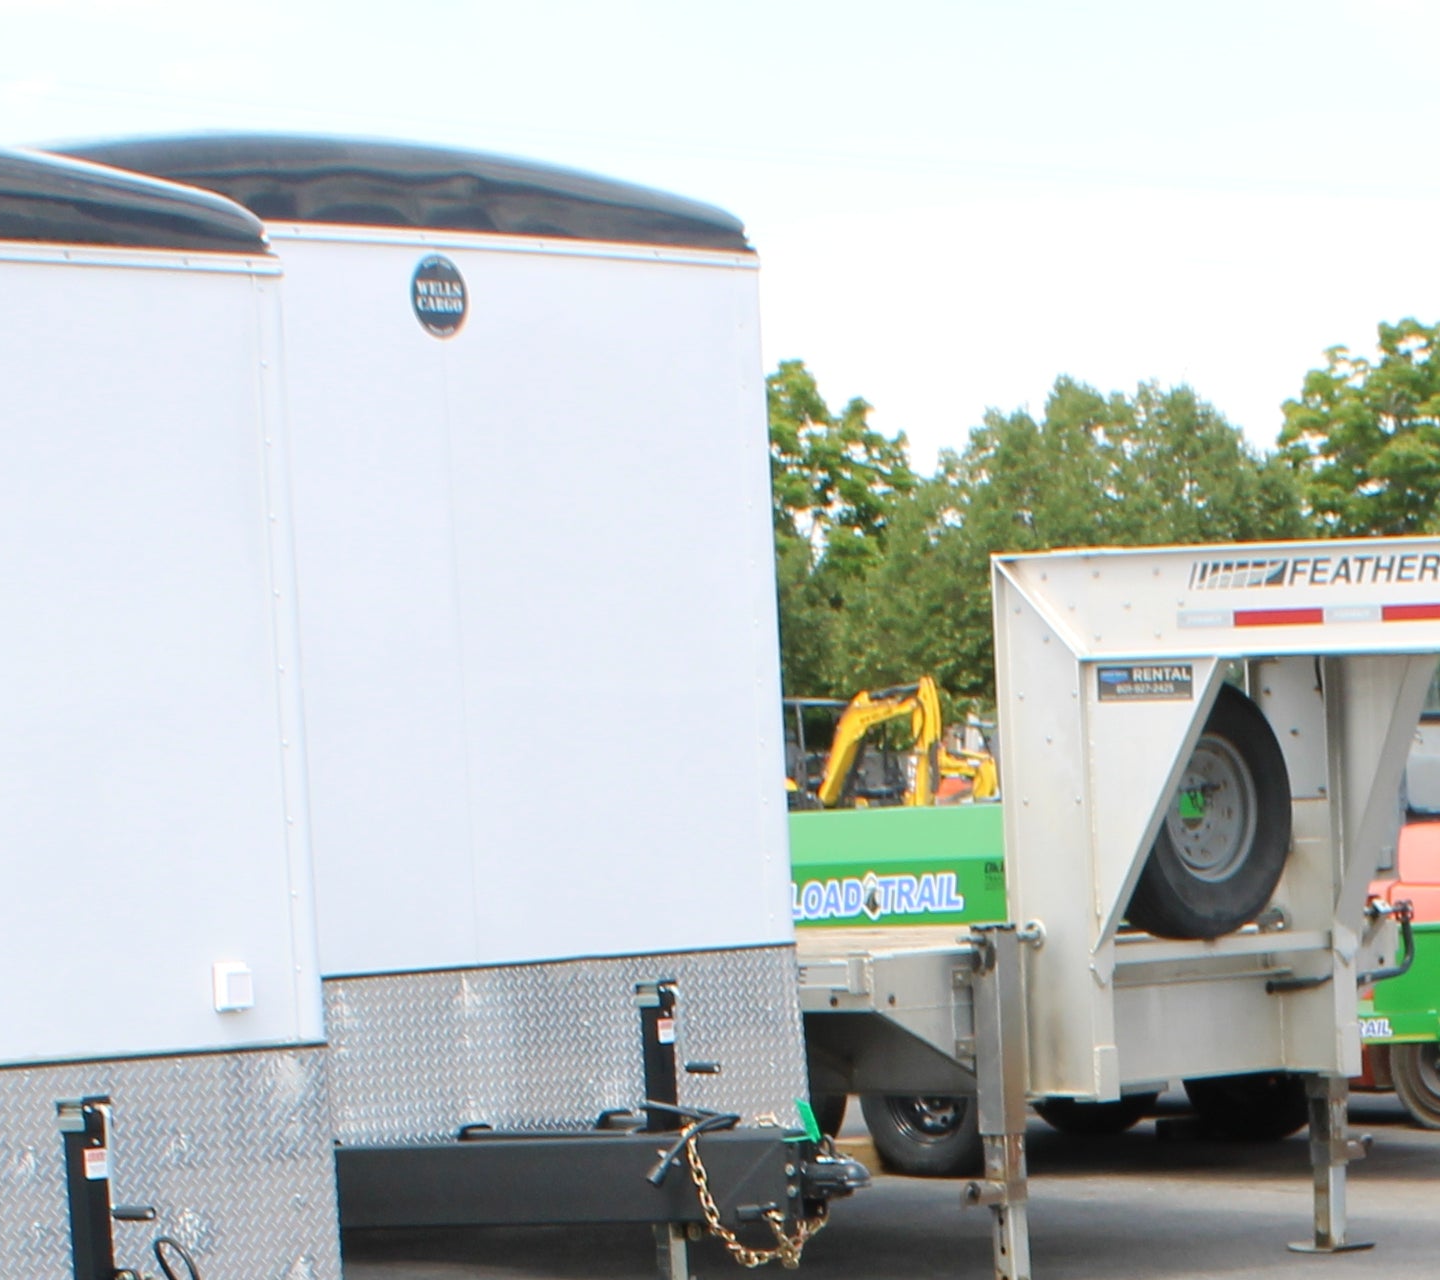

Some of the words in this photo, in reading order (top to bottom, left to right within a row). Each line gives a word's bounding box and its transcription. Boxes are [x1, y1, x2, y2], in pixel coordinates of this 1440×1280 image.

[416, 280, 462, 297] WELLS
[416, 296, 464, 314] CARGO
[1132, 666, 1191, 682] RENTAL
[792, 879, 863, 919] LOAD
[874, 873, 963, 912] TRAIL
